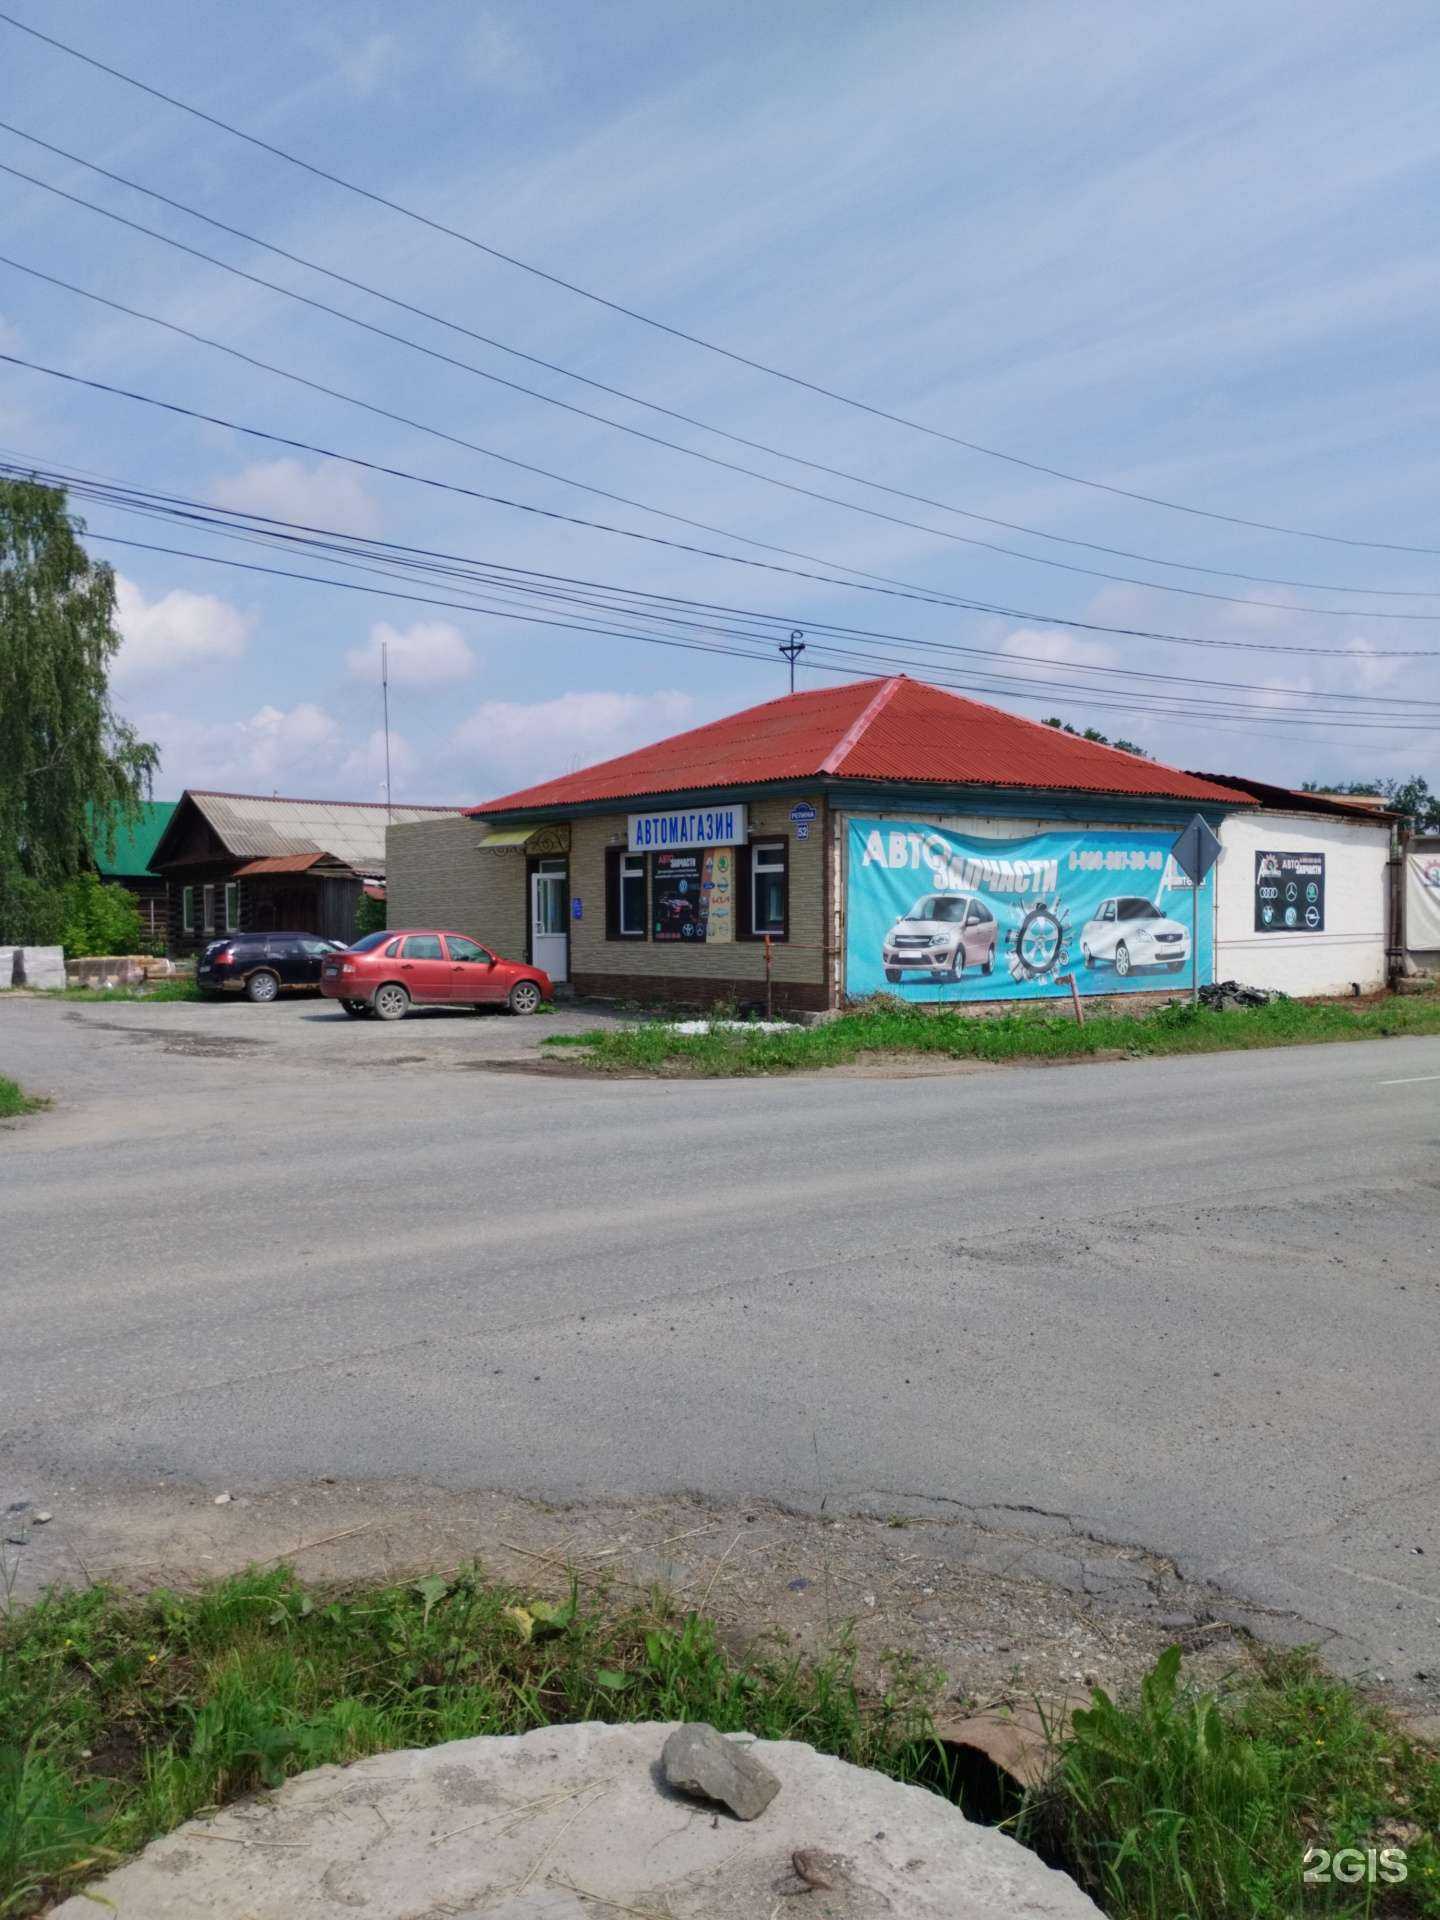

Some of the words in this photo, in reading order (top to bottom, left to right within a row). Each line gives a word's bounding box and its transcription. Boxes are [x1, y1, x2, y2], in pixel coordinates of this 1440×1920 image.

[636, 811, 734, 846] АВТОМАГАЗИН
[861, 830, 953, 871] АВТО
[932, 855, 1059, 893] ЗАПЧАСТИ
